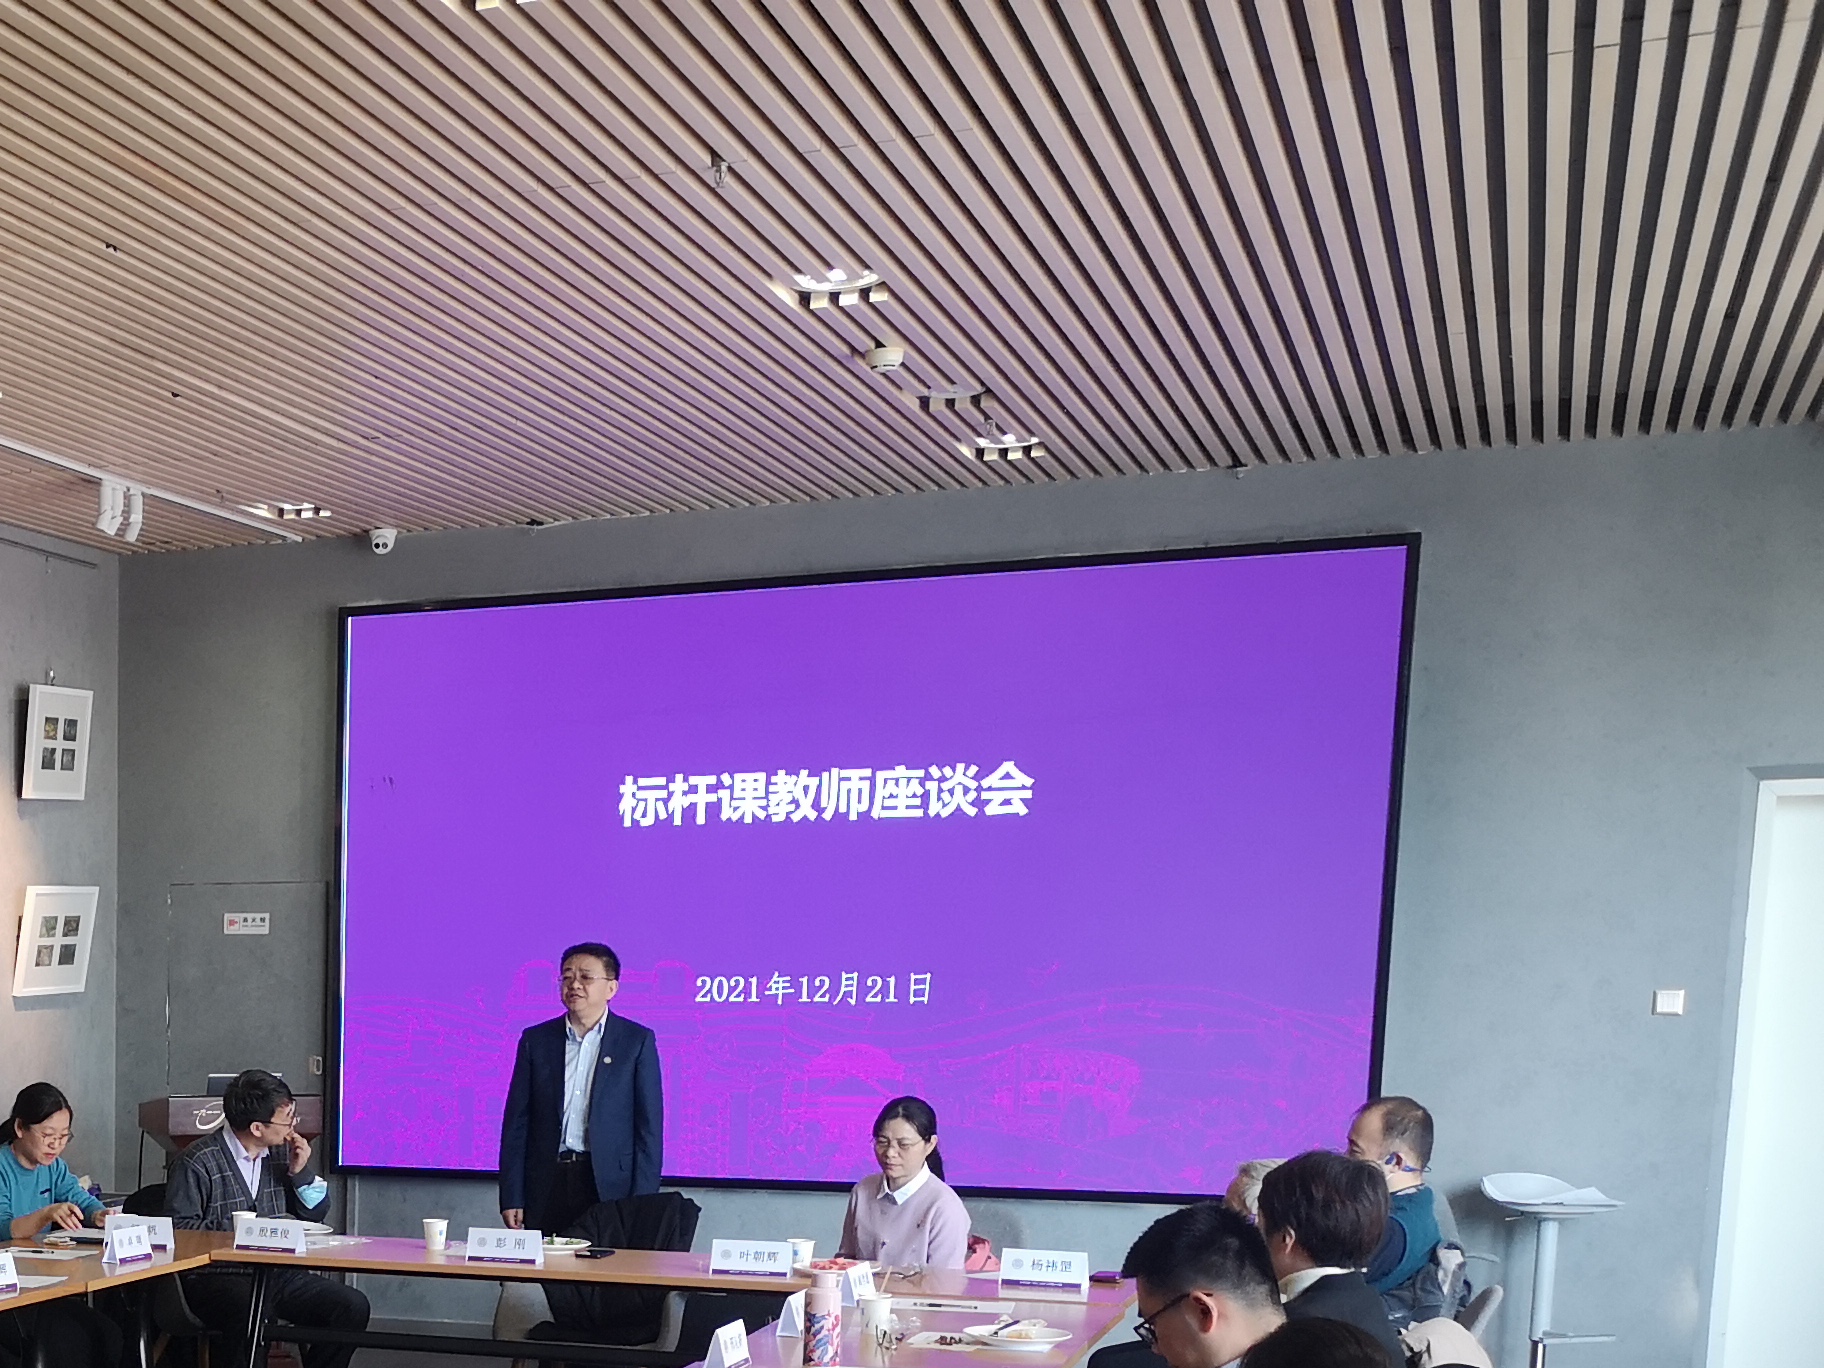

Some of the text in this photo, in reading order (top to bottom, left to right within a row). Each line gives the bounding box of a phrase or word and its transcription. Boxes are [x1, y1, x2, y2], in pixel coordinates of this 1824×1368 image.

[619, 761, 1035, 828] 标杆课教师座谈会
[695, 971, 933, 1006] 2021年12月21日
[495, 1236, 526, 1250] 彭刚
[739, 1250, 780, 1263] 叶朝辉
